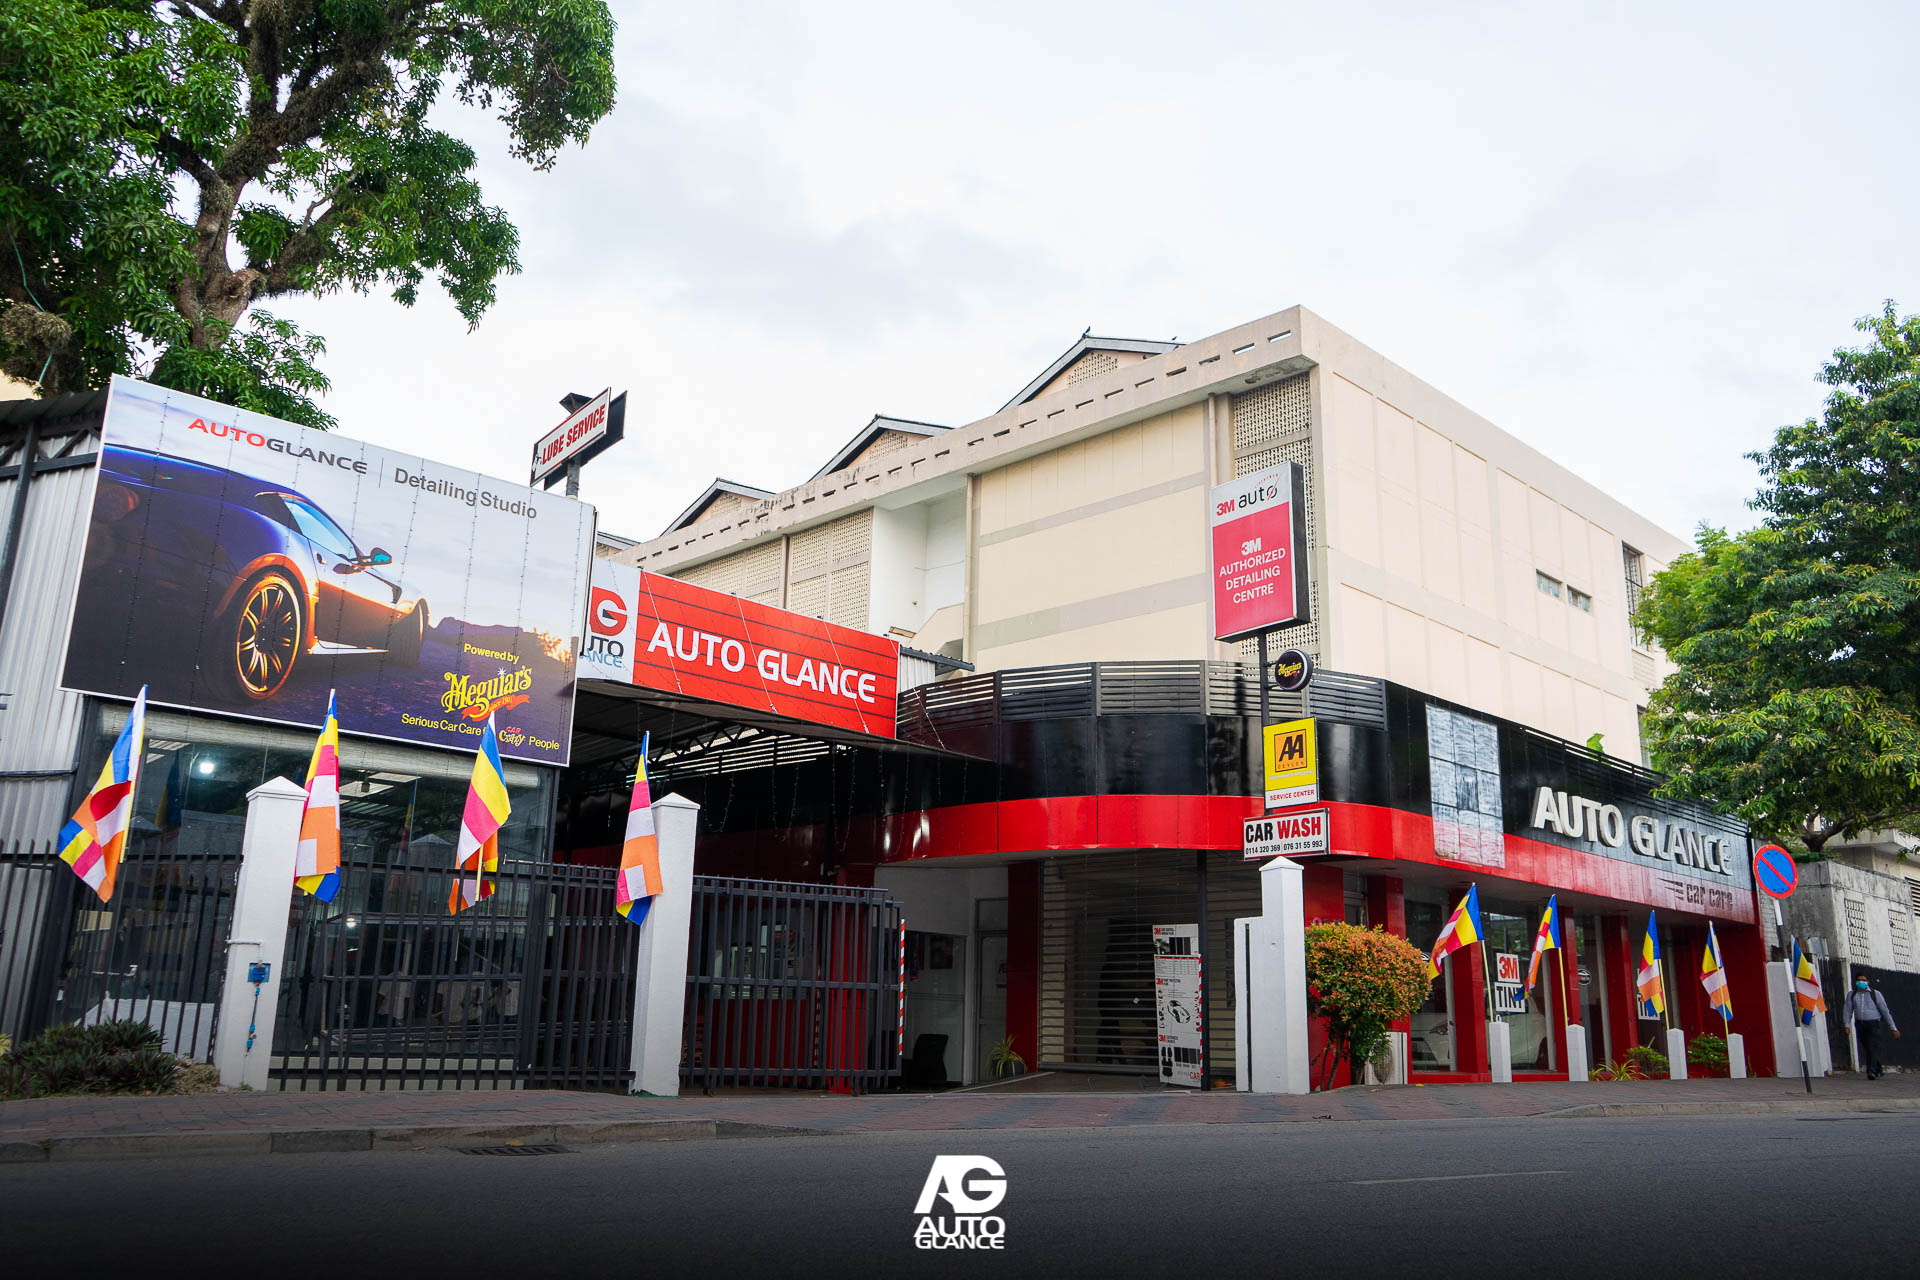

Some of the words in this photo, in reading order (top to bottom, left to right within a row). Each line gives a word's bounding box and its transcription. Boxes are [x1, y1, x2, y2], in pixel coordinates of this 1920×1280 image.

[542, 434, 565, 465] LUBE
[566, 403, 606, 448] SERVICE
[394, 467, 477, 507] Detailing
[480, 491, 538, 519] Studio
[1216, 499, 1235, 517] 3M
[1241, 537, 1262, 556] 3M
[1219, 547, 1286, 577] AUTHORIZED
[1225, 565, 1281, 591] DETAILING
[1232, 583, 1274, 604] CENTRE
[463, 643, 506, 661] Powered
[507, 651, 520, 665] by
[647, 621, 746, 673] AUTO
[757, 648, 876, 704] GLANCE
[441, 665, 532, 718] Meguiar's
[401, 713, 439, 729] Serious
[440, 719, 458, 732] Car
[458, 722, 481, 736] Care
[528, 735, 560, 751] People
[1279, 733, 1304, 762] AA
[1270, 792, 1292, 801] SERVICE
[1293, 789, 1315, 798] CENTER
[1245, 822, 1274, 843] CAR
[1276, 816, 1322, 839] WASH
[1531, 785, 1625, 848] AUTO
[1630, 815, 1734, 876] GLANCE
[1295, 842, 1302, 850] 31
[1303, 841, 1311, 849] 55
[1686, 883, 1706, 906] car
[1708, 888, 1733, 909] care
[1498, 955, 1519, 980] 3M
